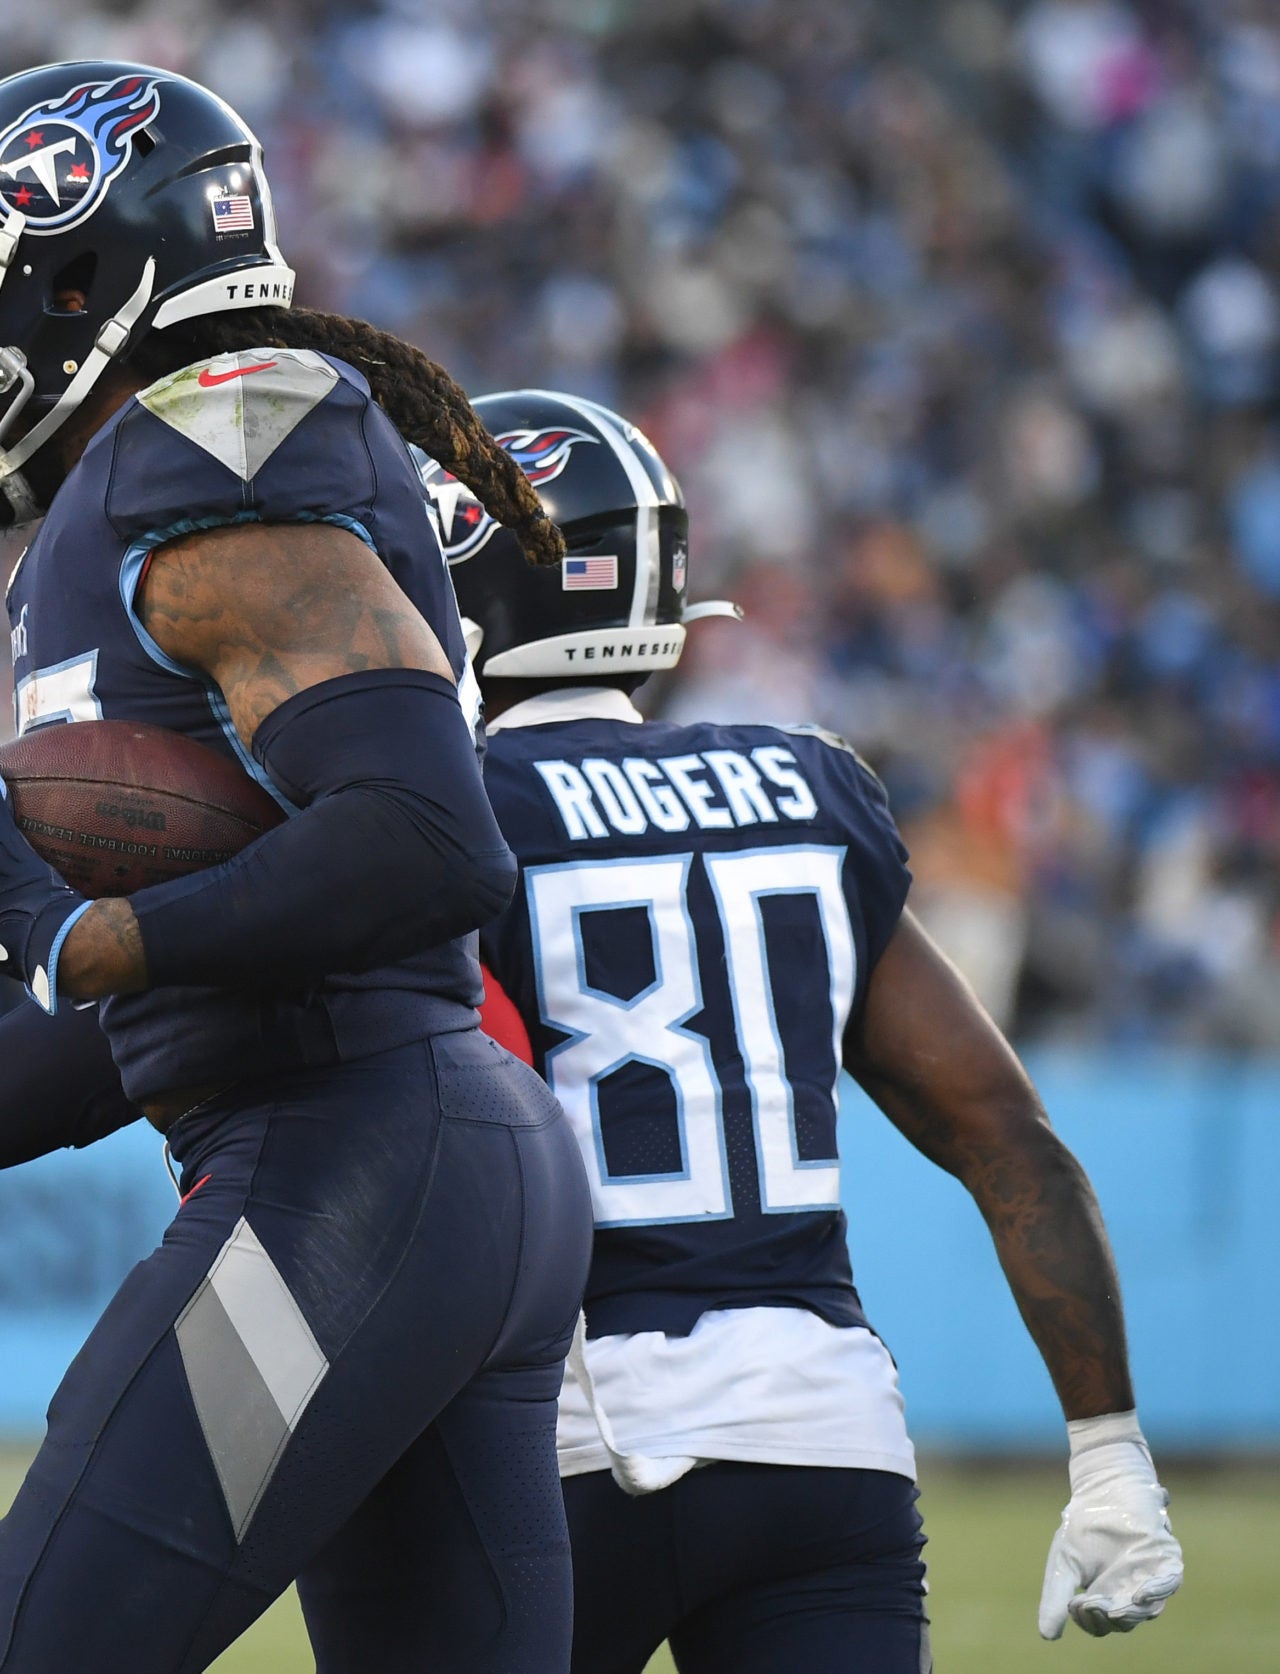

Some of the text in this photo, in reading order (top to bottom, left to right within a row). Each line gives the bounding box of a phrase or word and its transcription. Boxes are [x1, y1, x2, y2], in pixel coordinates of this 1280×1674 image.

[532, 744, 819, 841] ROGERS
[21, 817, 73, 840] LEAGUE
[79, 832, 157, 857] FOOTBALL
[523, 843, 857, 1230] 80
